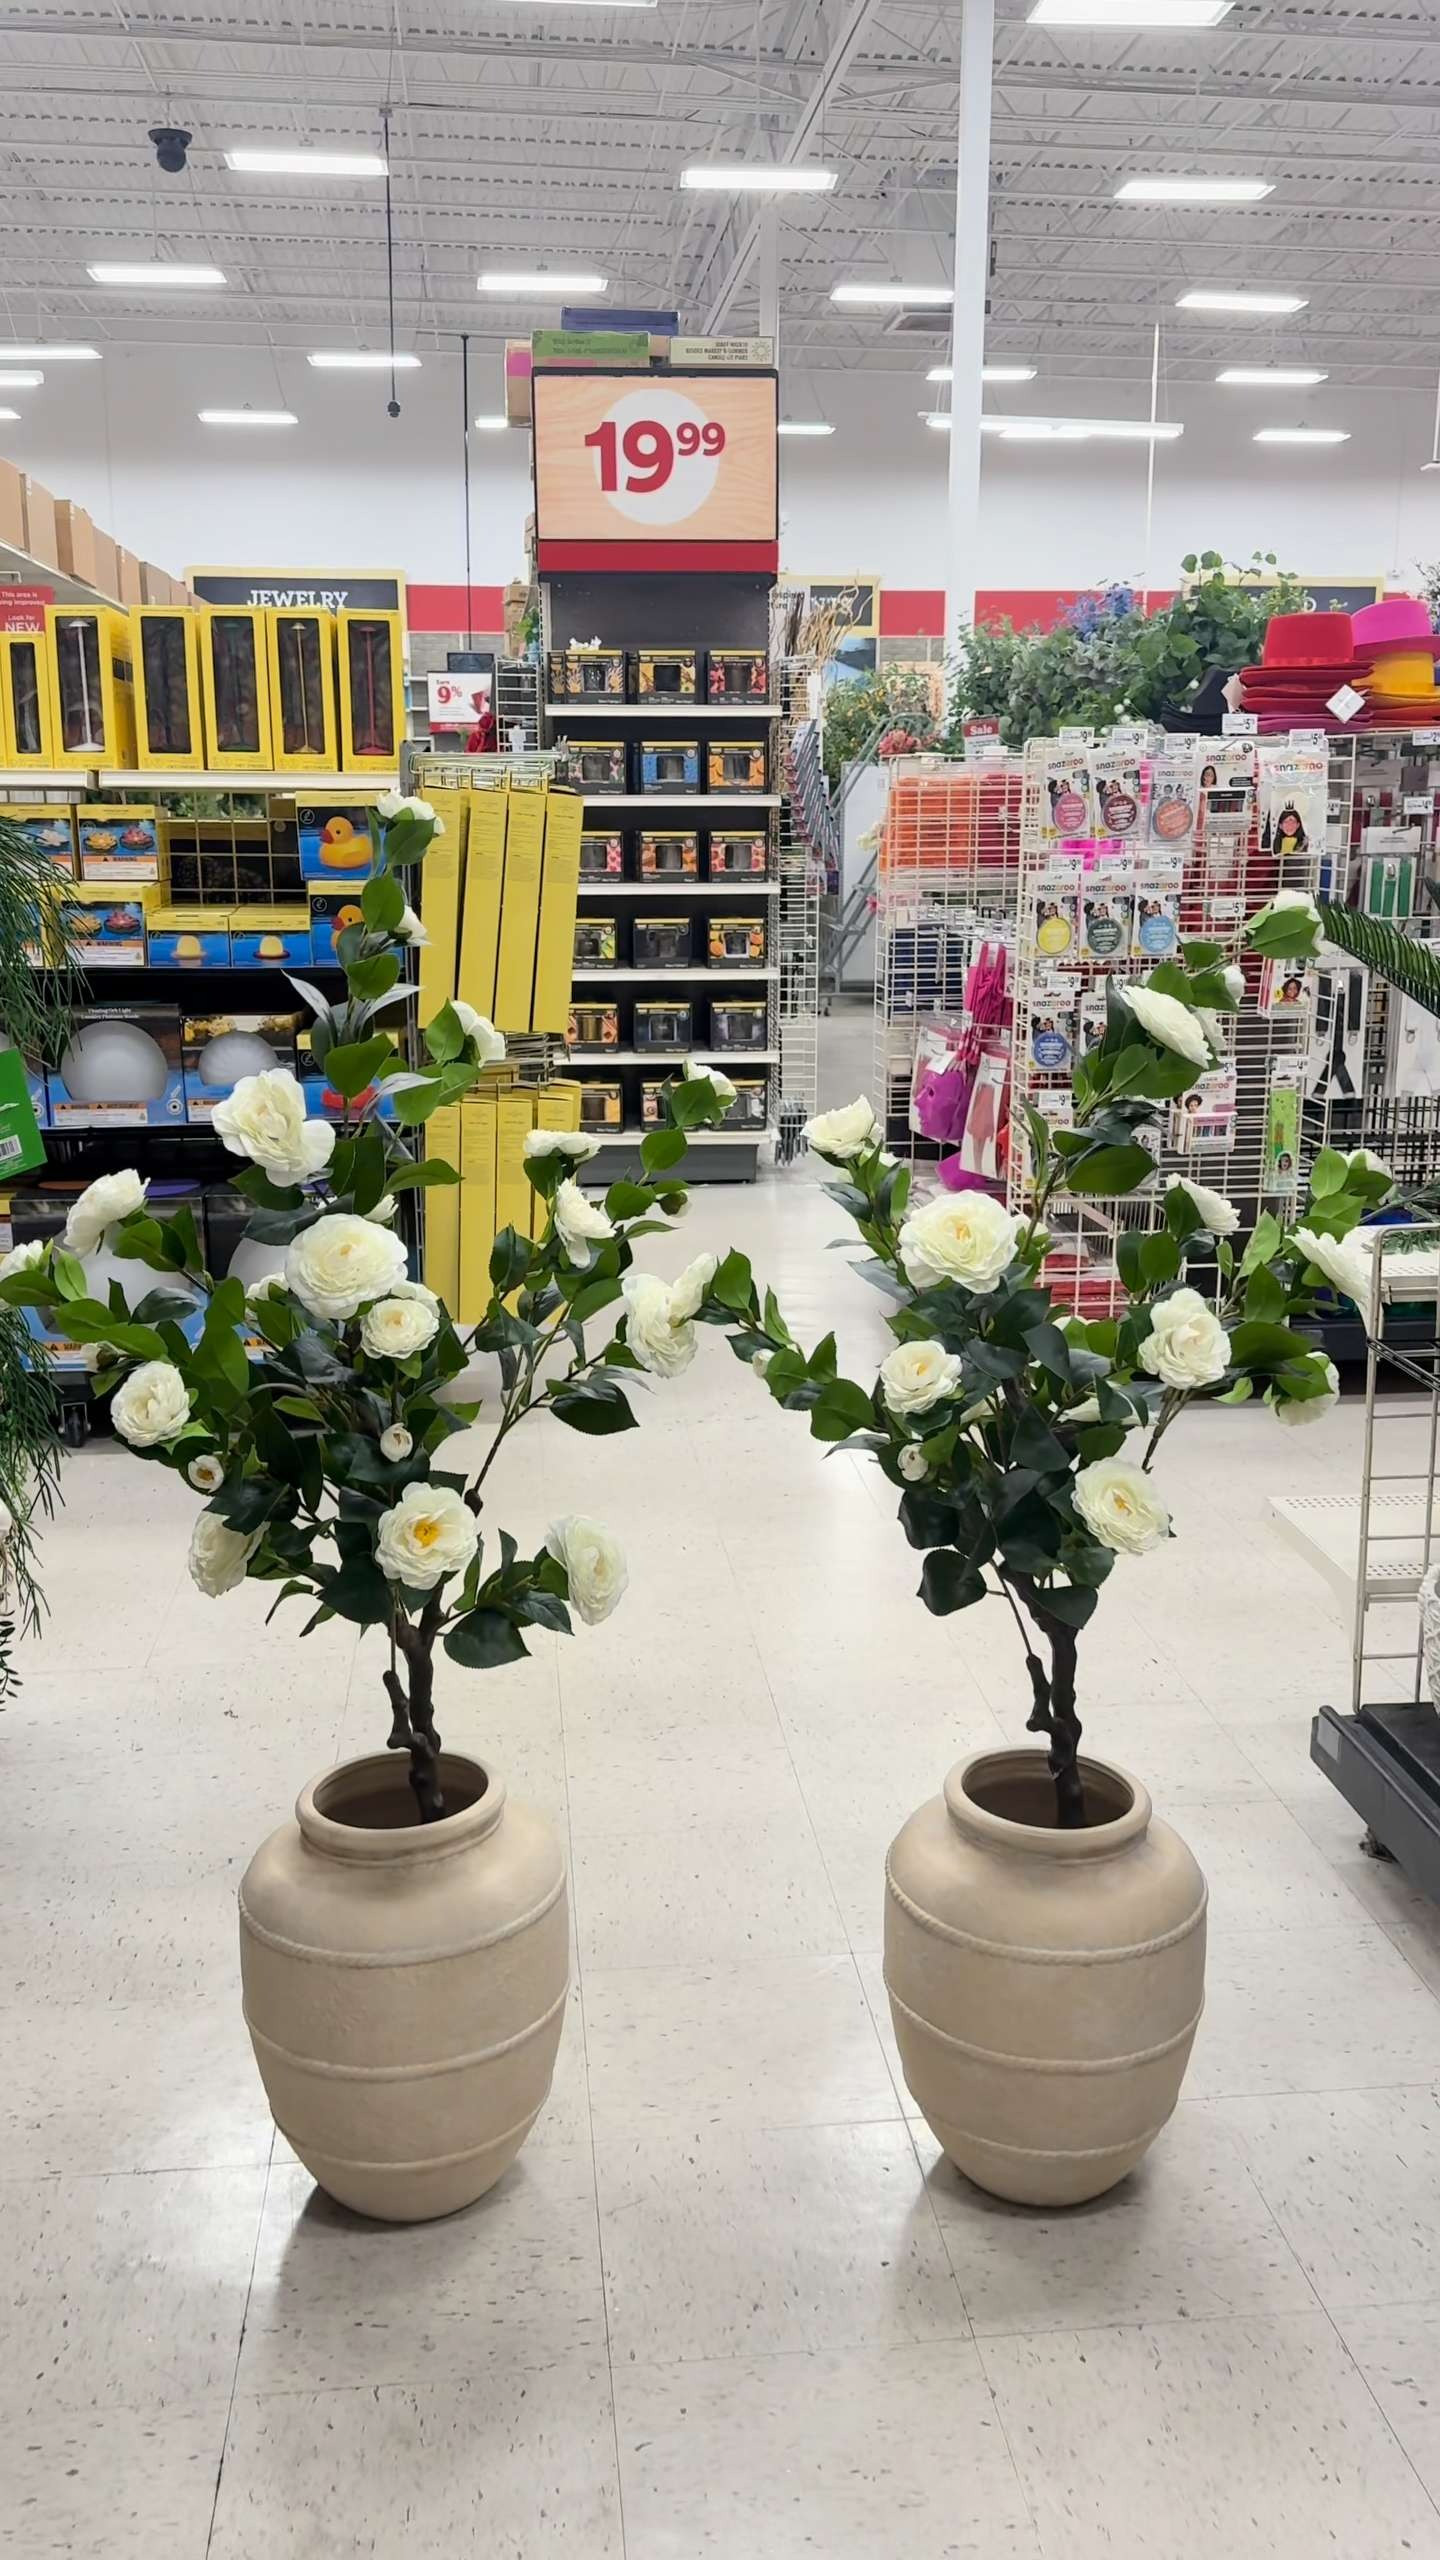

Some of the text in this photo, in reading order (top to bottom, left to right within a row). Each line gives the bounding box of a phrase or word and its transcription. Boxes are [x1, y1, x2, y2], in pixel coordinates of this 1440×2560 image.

[246, 589, 349, 608] JEWELRY
[4, 622, 40, 632] NEW
[970, 724, 993, 736] Sale
[1206, 753, 1247, 762] snazaroo
[1047, 758, 1084, 770] snazaroo
[1095, 758, 1136, 770] snazaroo
[1036, 883, 1075, 892] snazaroo
[1085, 884, 1127, 892] snazaroo
[1140, 881, 1180, 889] snazaroo
[1032, 1000, 1071, 1008] snazaroo
[1085, 1004, 1105, 1012] snaz
[1191, 1083, 1229, 1091] nazaroo
